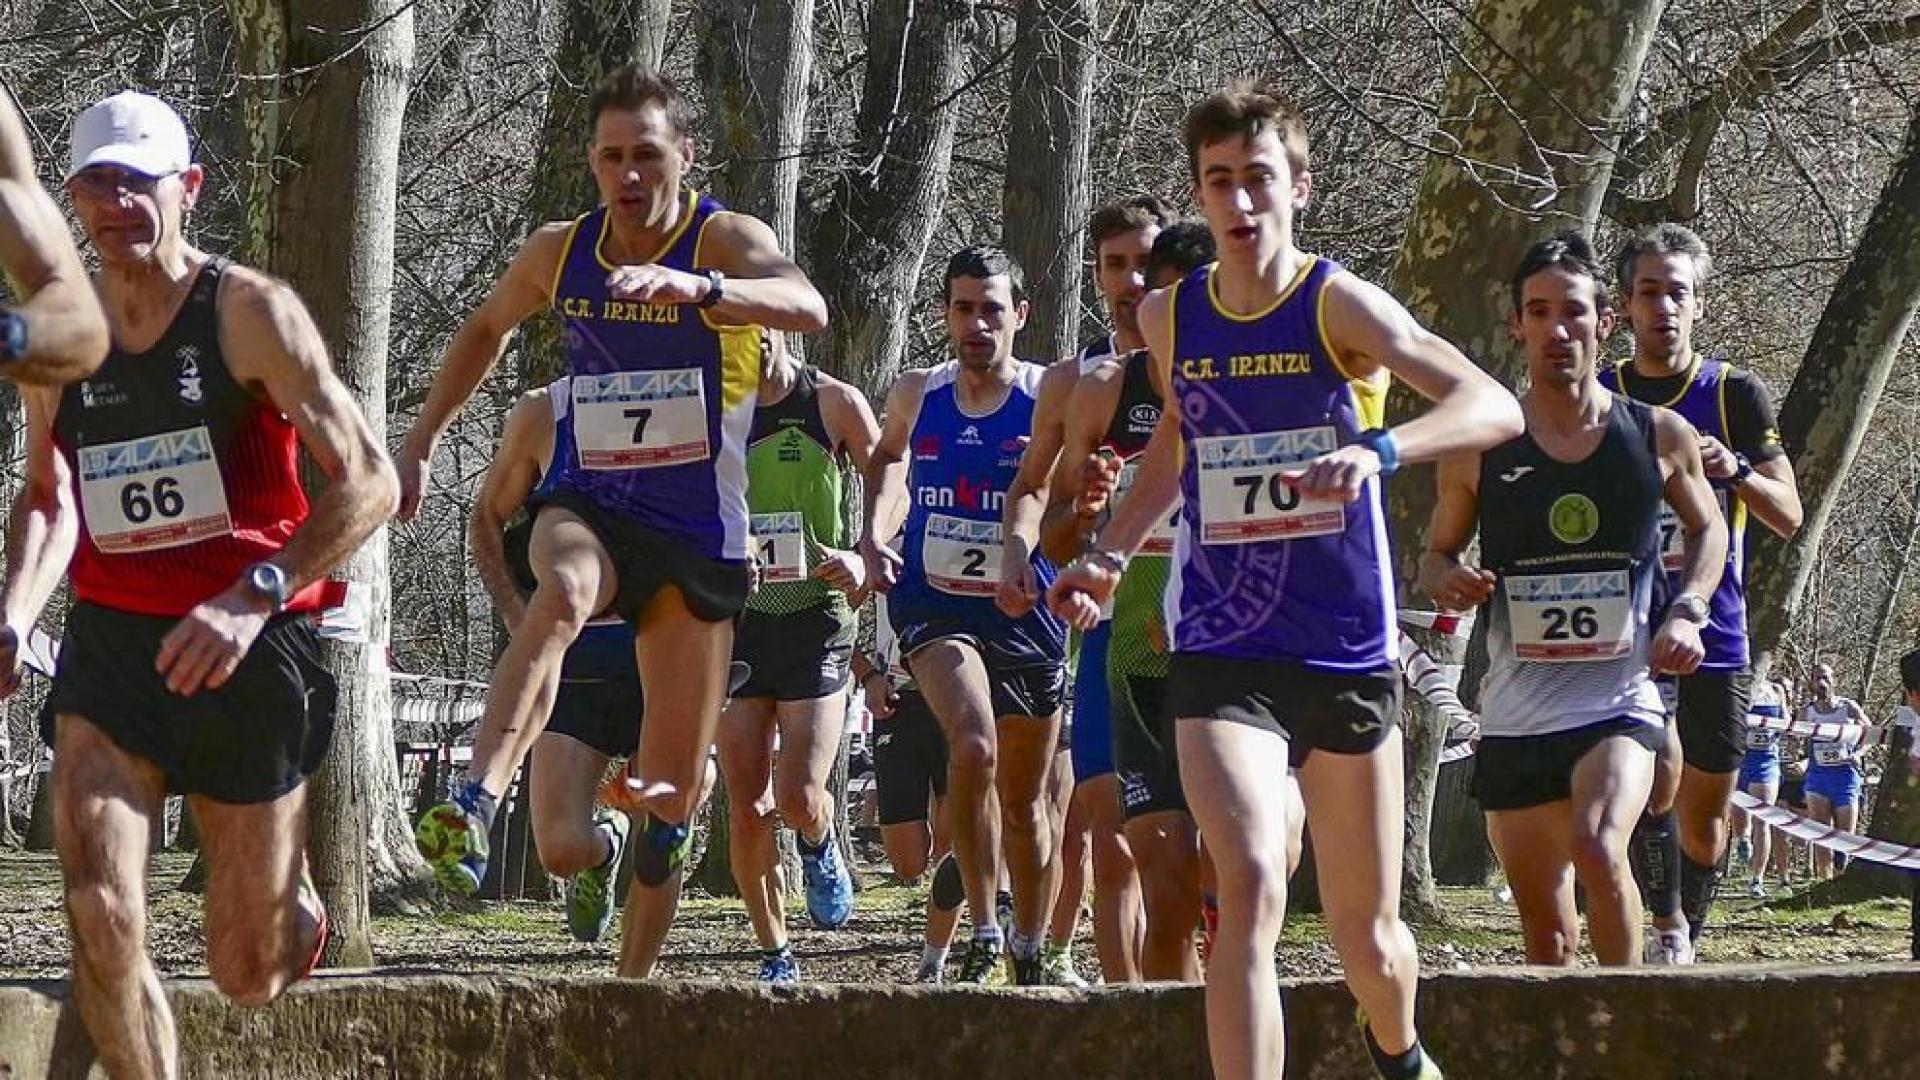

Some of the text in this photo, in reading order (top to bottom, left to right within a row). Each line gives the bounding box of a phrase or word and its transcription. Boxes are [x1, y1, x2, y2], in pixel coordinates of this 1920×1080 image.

[603, 301, 680, 323] IRANZU
[1182, 353, 1312, 379] C.A. IRANZU
[576, 371, 699, 395] BALAKI
[623, 408, 652, 444] 7
[1204, 430, 1331, 461] BALAKI
[120, 476, 186, 524] 66
[1233, 472, 1302, 515] 70
[961, 548, 986, 577] 2
[1541, 606, 1599, 641] 26
